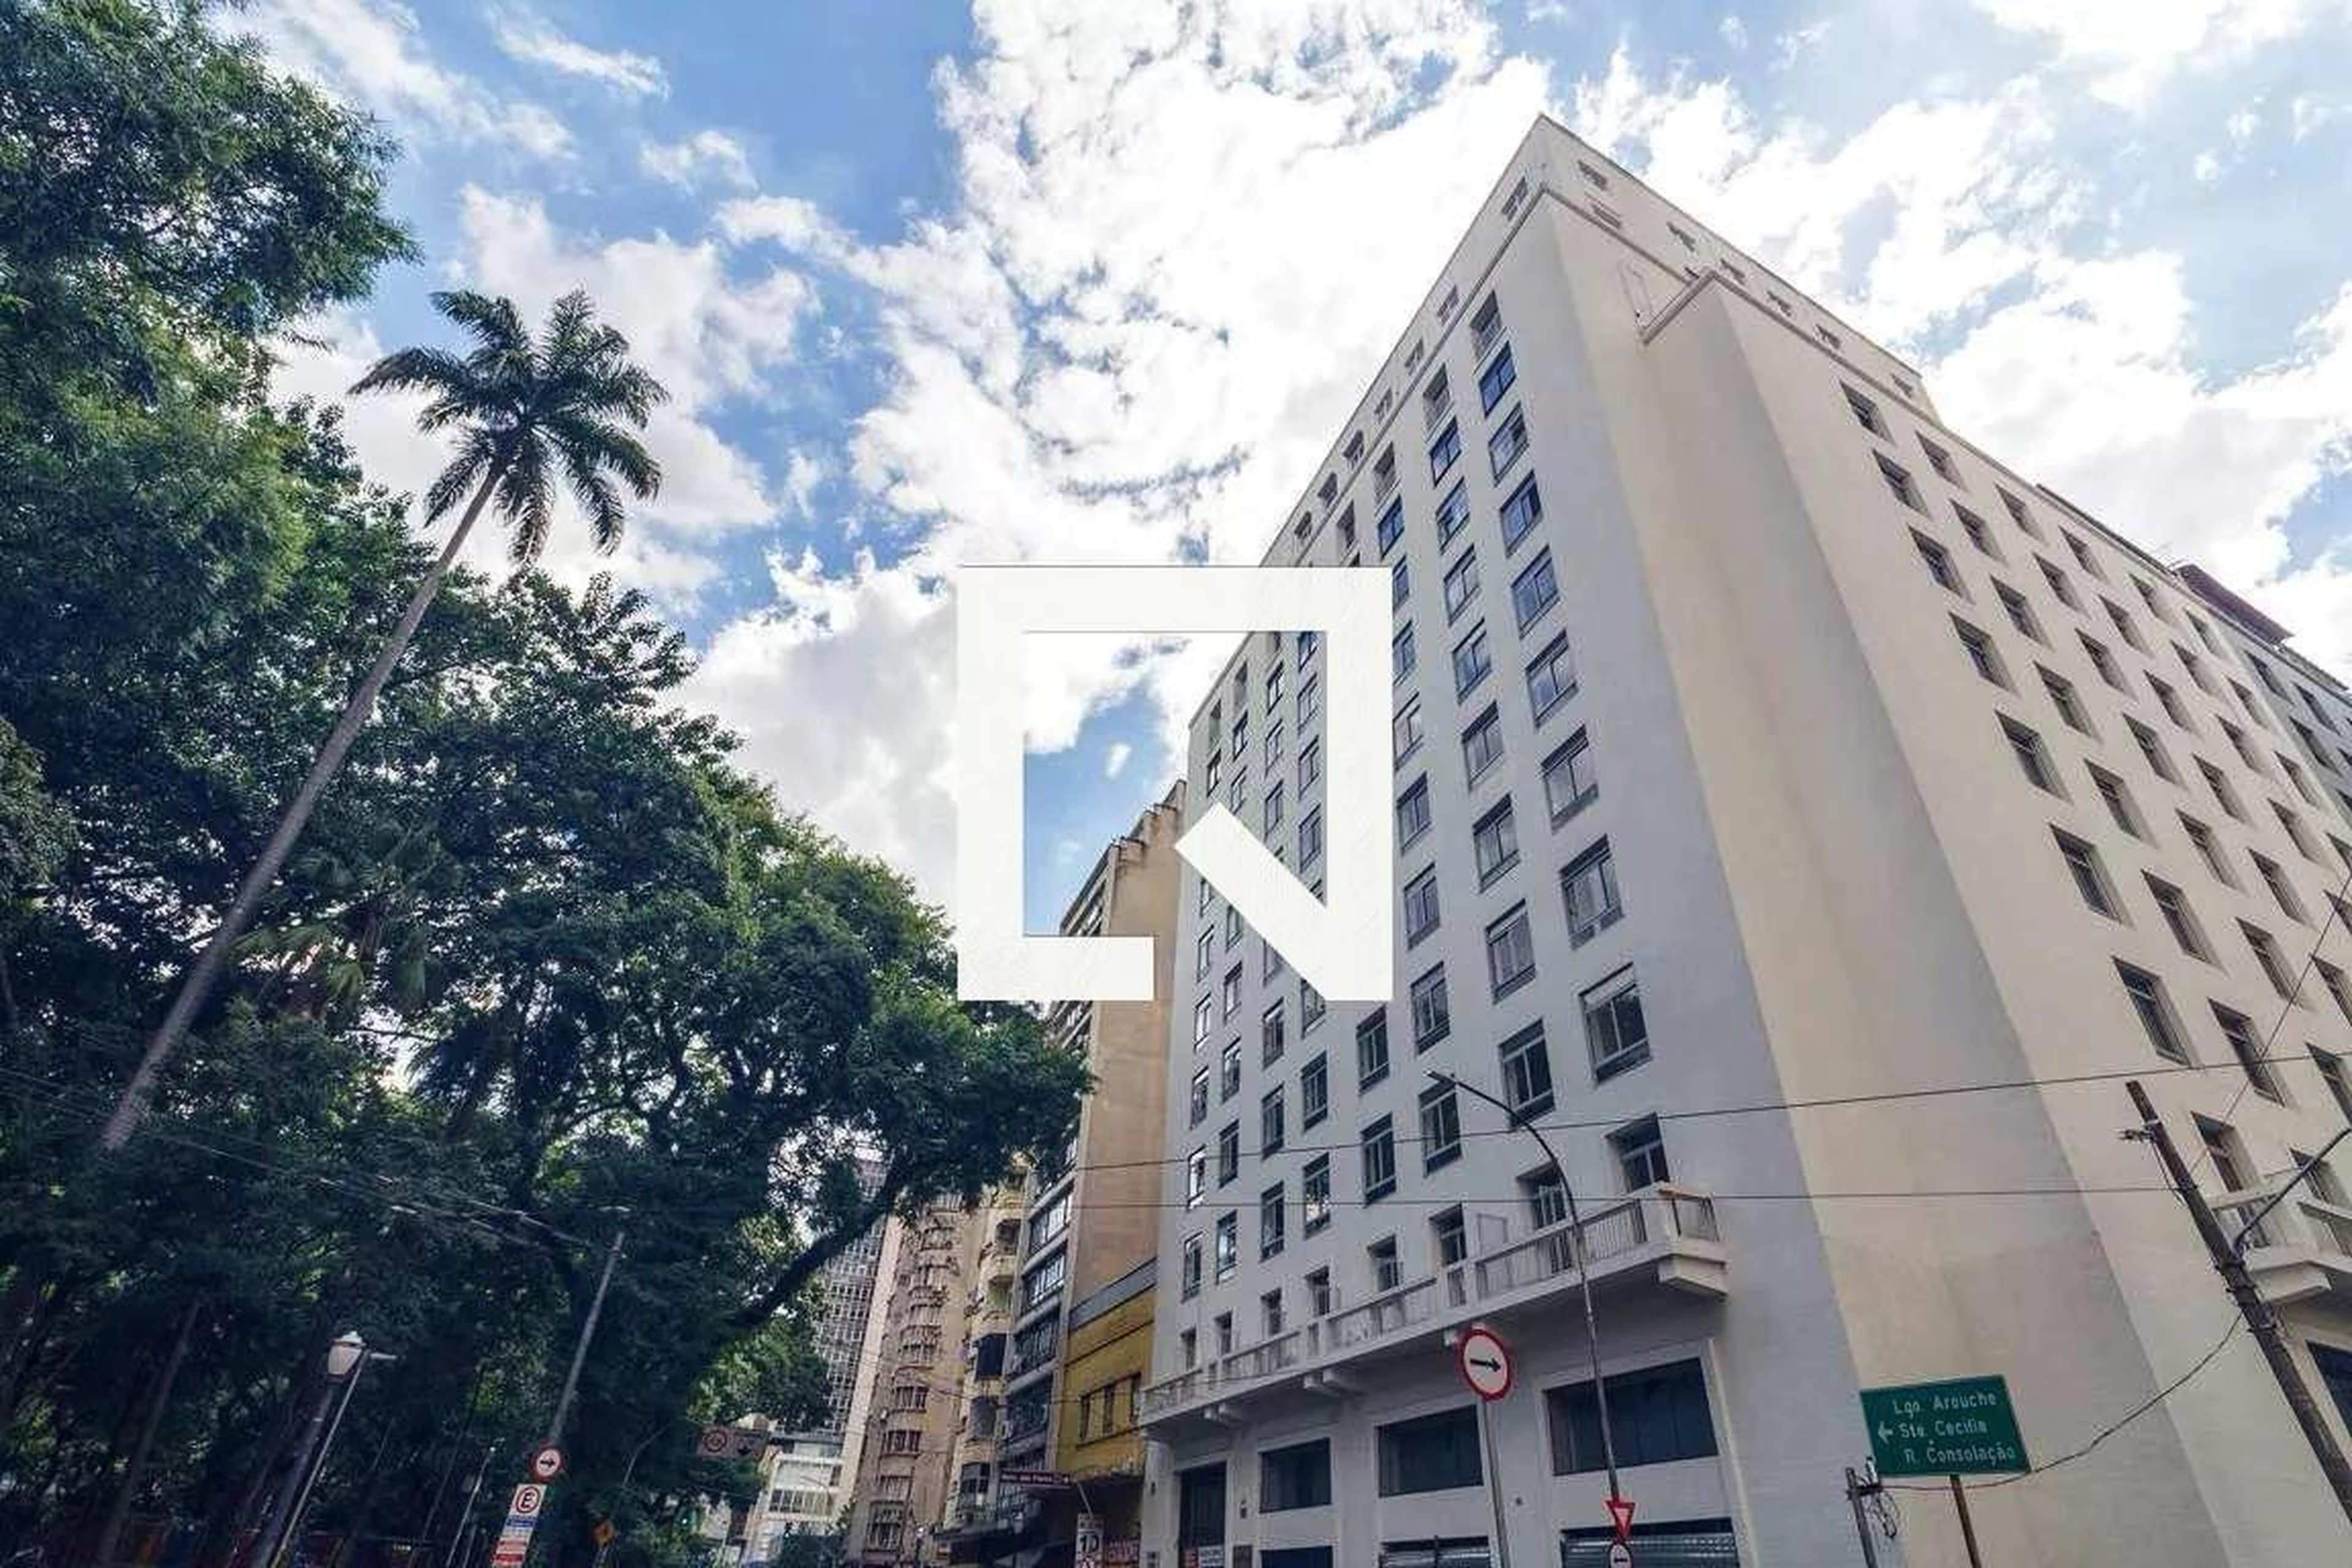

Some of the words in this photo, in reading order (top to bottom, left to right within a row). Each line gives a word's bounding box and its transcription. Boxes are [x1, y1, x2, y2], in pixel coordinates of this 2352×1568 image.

[1932, 1392, 1997, 1411] Arouche
[1926, 1442, 2016, 1466] Consolação
[521, 1492, 535, 1508] E
